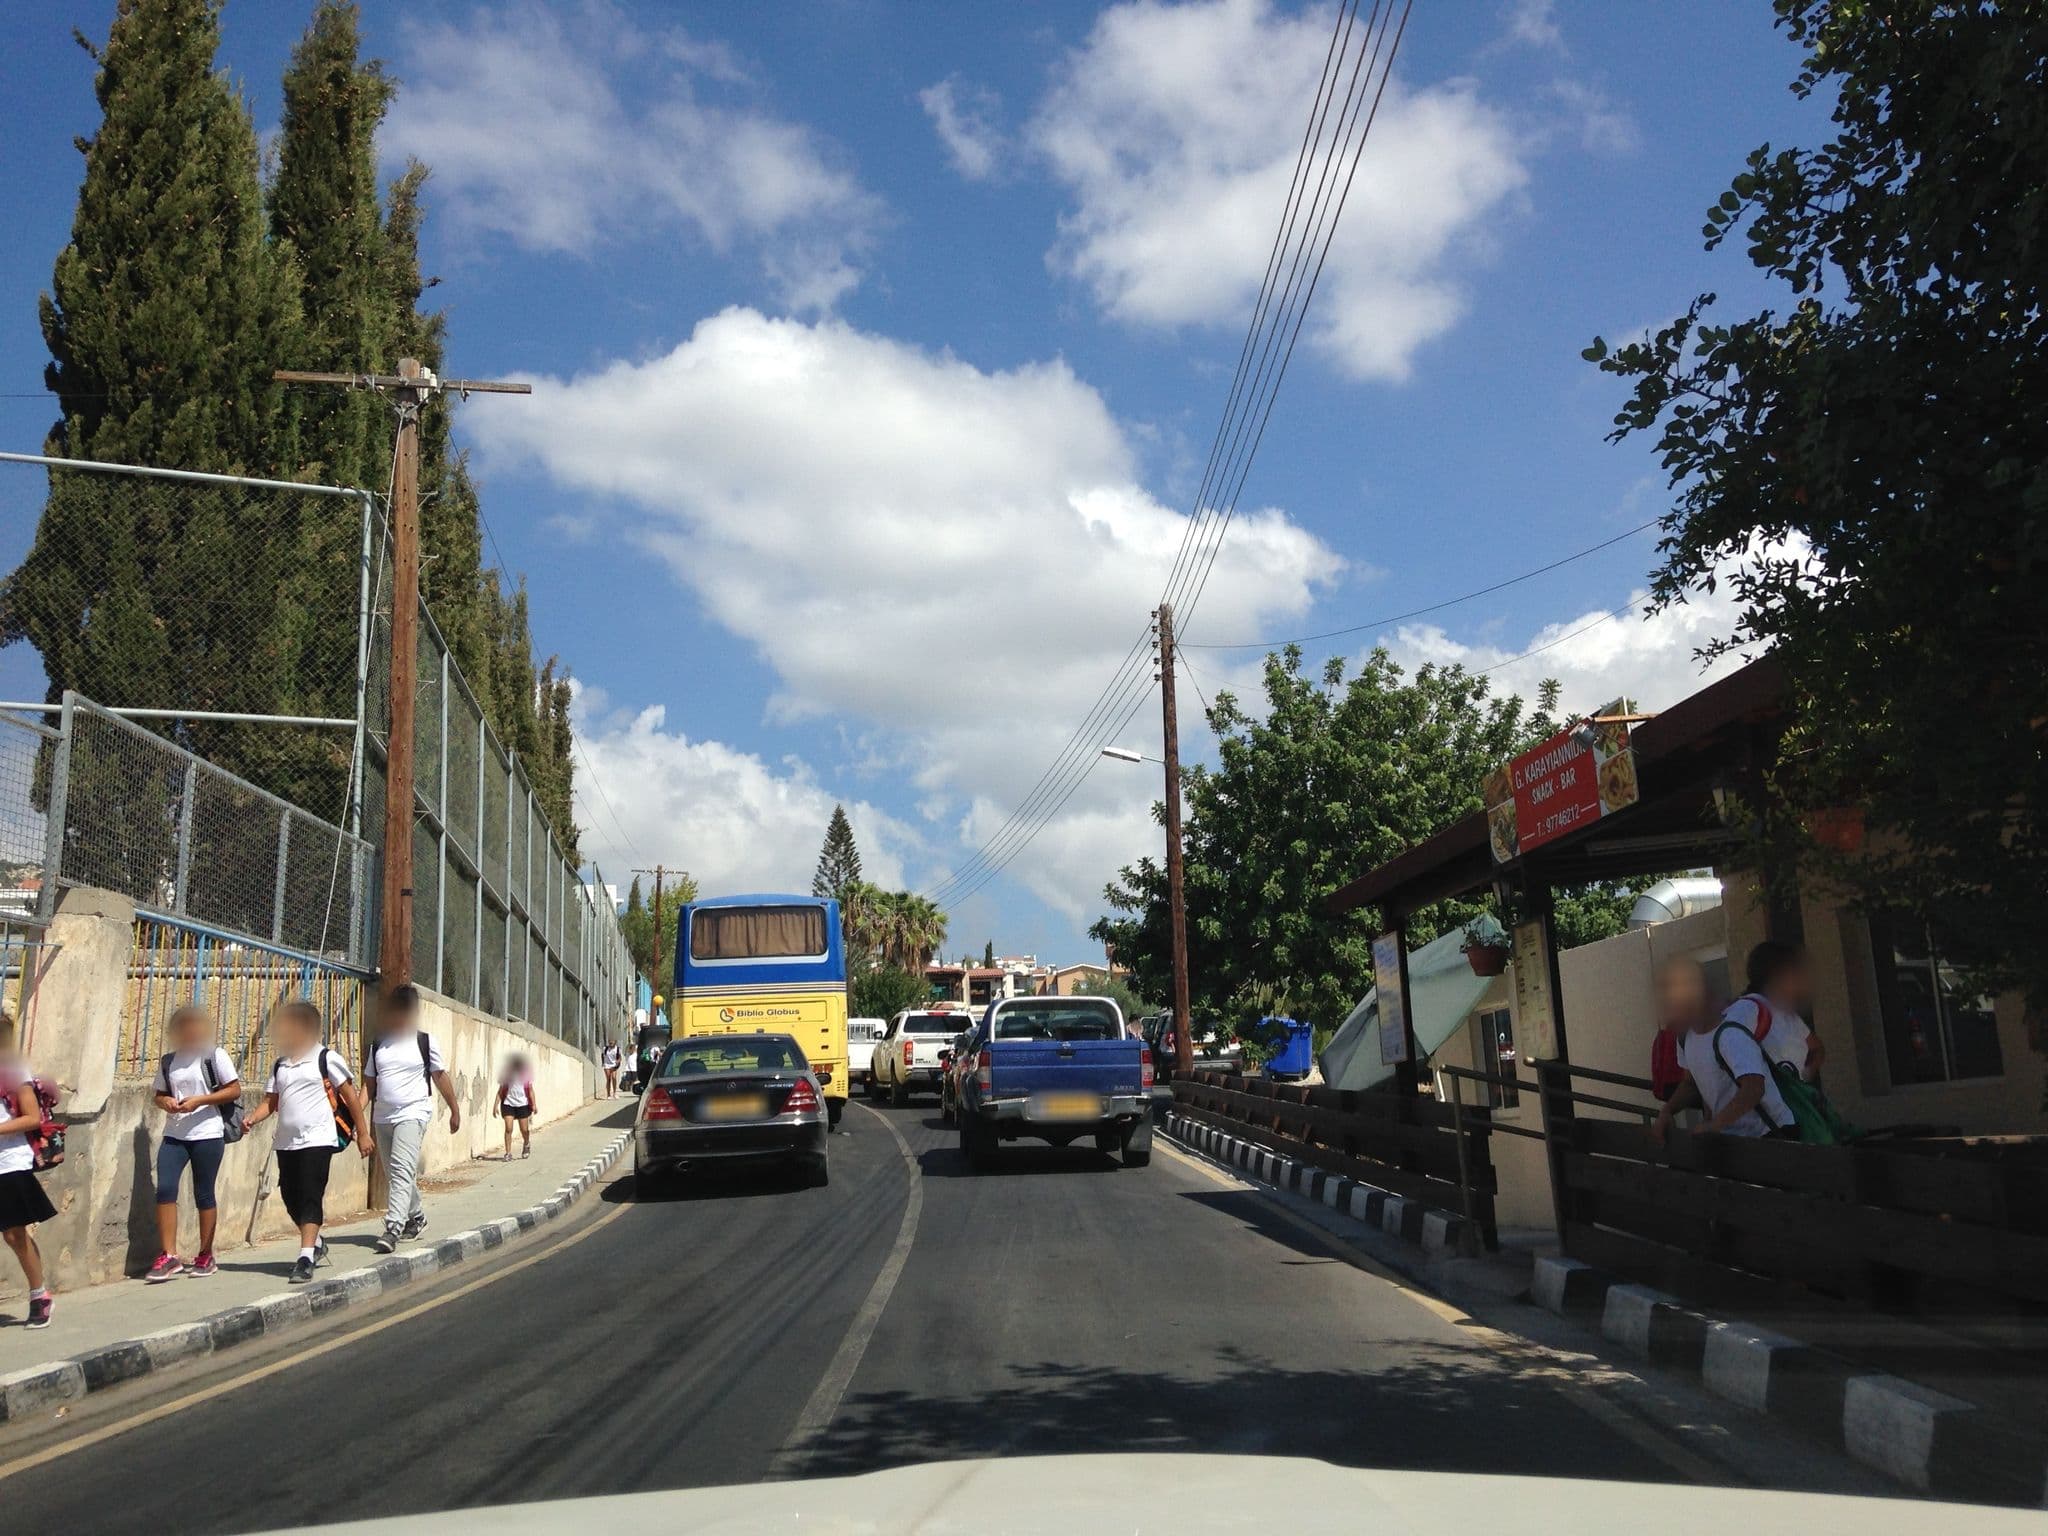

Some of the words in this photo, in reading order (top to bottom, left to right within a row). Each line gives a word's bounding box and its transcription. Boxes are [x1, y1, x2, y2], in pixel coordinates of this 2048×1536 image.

[1515, 770, 1524, 789] G.
[1532, 779, 1554, 805] SNACK
[1560, 767, 1576, 790] BAR
[736, 1009, 764, 1017] Biblio
[766, 1008, 800, 1016] Globus
